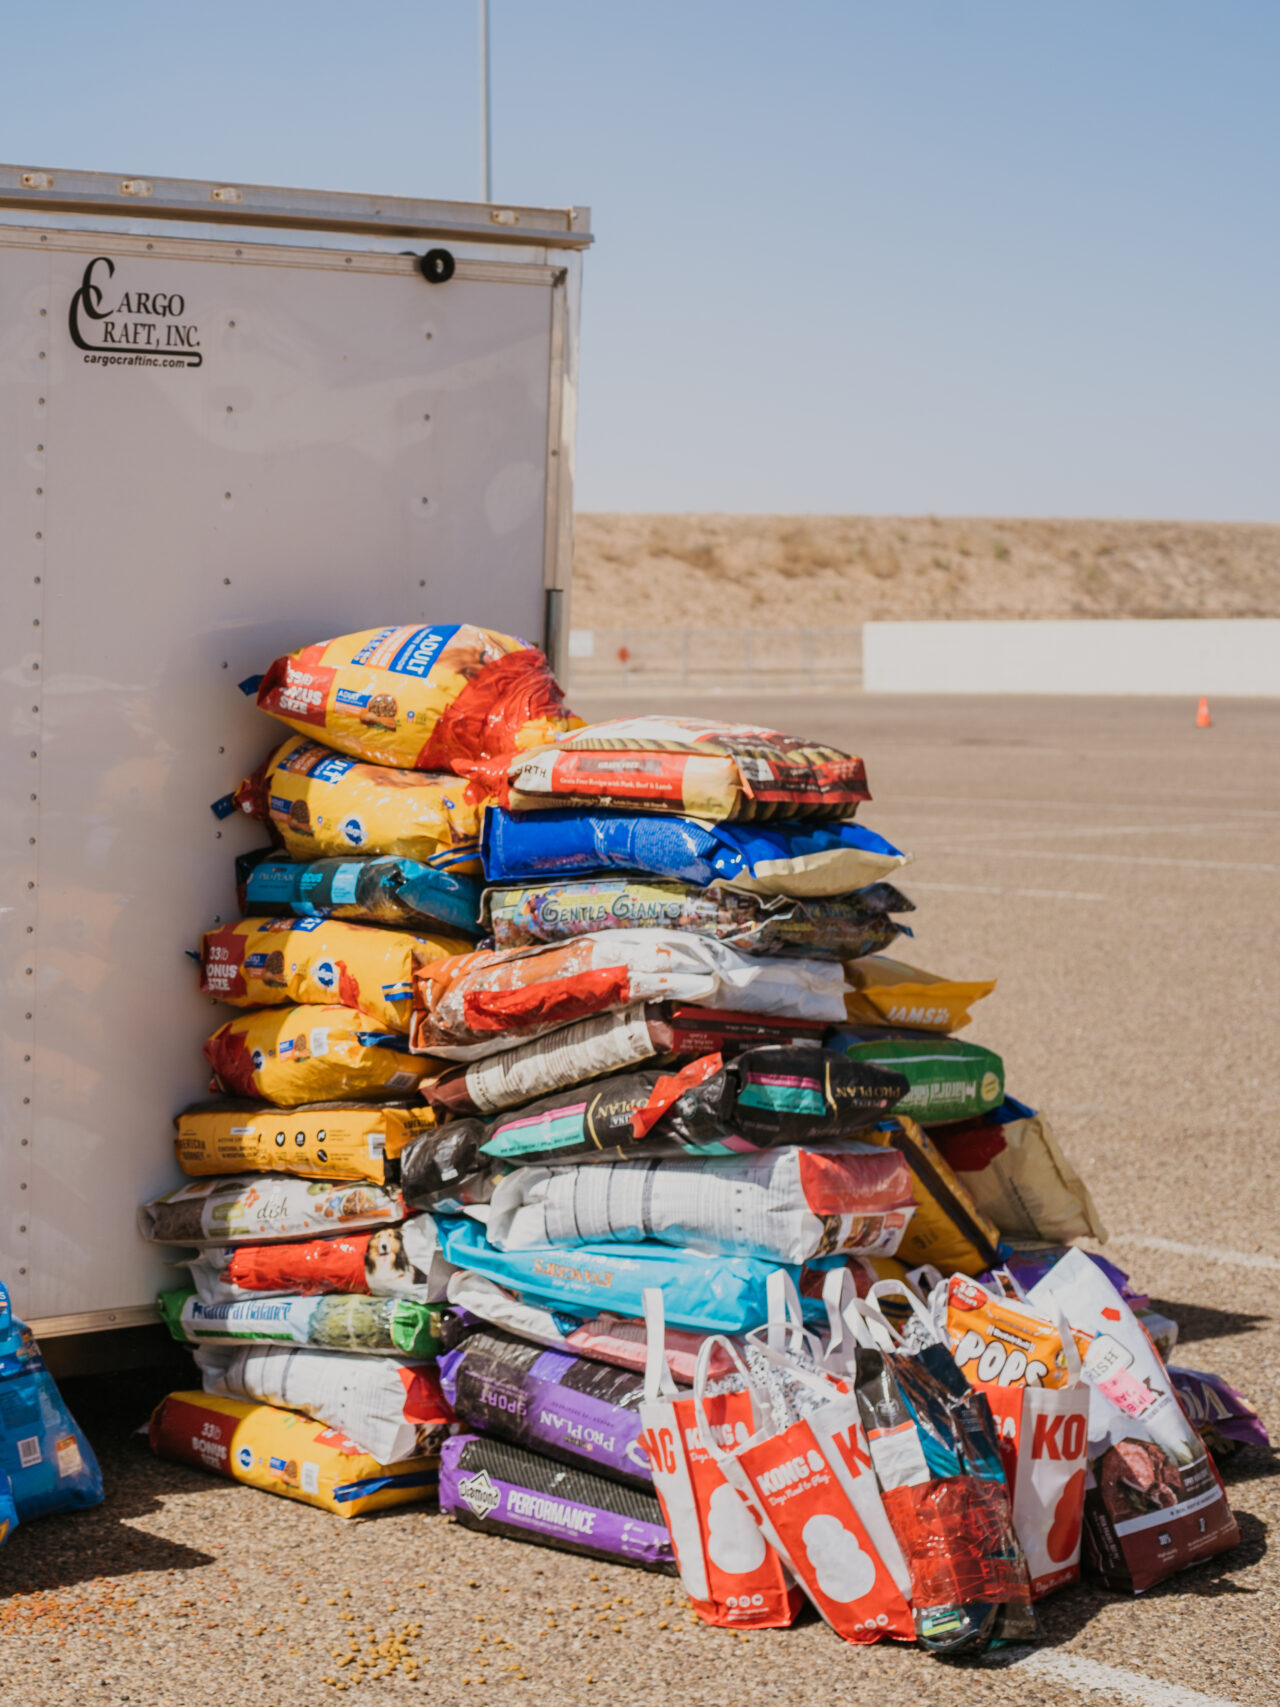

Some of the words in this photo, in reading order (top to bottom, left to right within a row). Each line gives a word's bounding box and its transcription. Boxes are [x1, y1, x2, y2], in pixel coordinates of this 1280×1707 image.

[82, 257, 185, 320] CARGO
[165, 324, 201, 348] INC.
[83, 353, 185, 368] cargocraftinc.com
[406, 633, 443, 676] ADULT
[540, 899, 607, 924] GENTLE
[611, 894, 682, 919] GIANTS
[206, 963, 238, 979] ONUS
[887, 1005, 934, 1024] IAMS
[835, 1086, 872, 1098] PLAN
[256, 1196, 289, 1221] dish
[532, 1258, 614, 1288] EVANGER'S
[192, 1301, 244, 1321] Natural
[245, 1301, 294, 1321] Balance
[954, 1329, 1049, 1388] POPS
[480, 1387, 528, 1417] SPORT
[539, 1409, 585, 1441] PLAN
[1031, 1413, 1087, 1461] KO
[192, 1437, 227, 1460] BONUS
[583, 1428, 616, 1452] PRO
[756, 1455, 810, 1496] KONG
[459, 1485, 501, 1507] Diamond
[507, 1489, 597, 1535] PERFORMANCE
